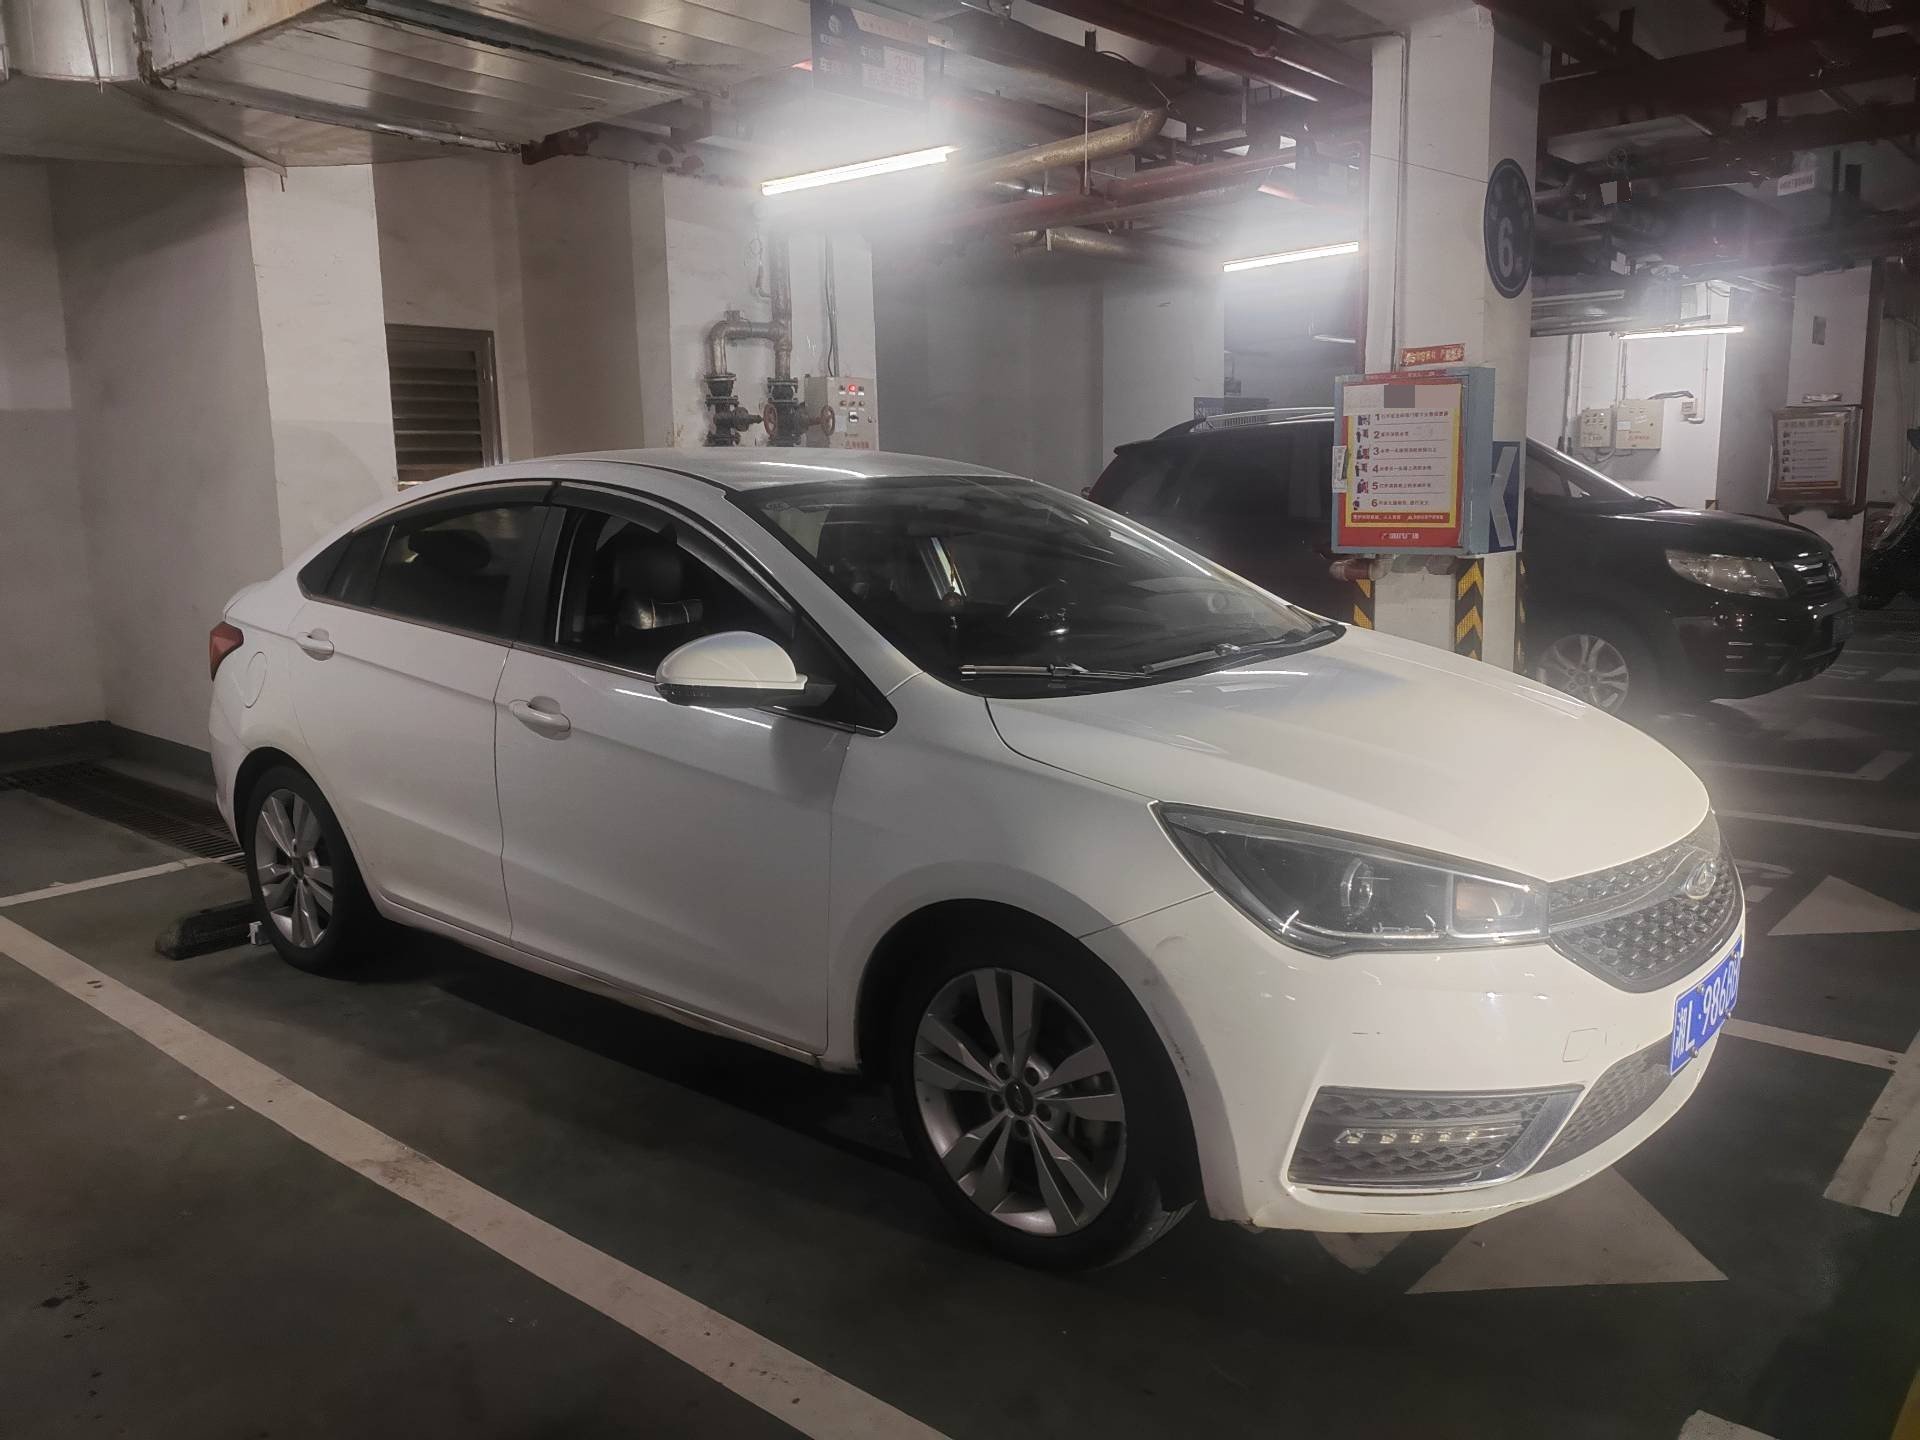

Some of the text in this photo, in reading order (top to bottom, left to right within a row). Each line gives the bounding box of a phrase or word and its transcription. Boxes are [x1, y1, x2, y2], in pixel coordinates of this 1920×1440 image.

[1498, 217, 1513, 277] 6
[1375, 413, 1380, 421] 1
[1373, 430, 1380, 439] 2
[1373, 447, 1379, 455] 3
[1372, 464, 1379, 474] 4
[1372, 481, 1379, 490] 5
[1371, 499, 1378, 507] 6
